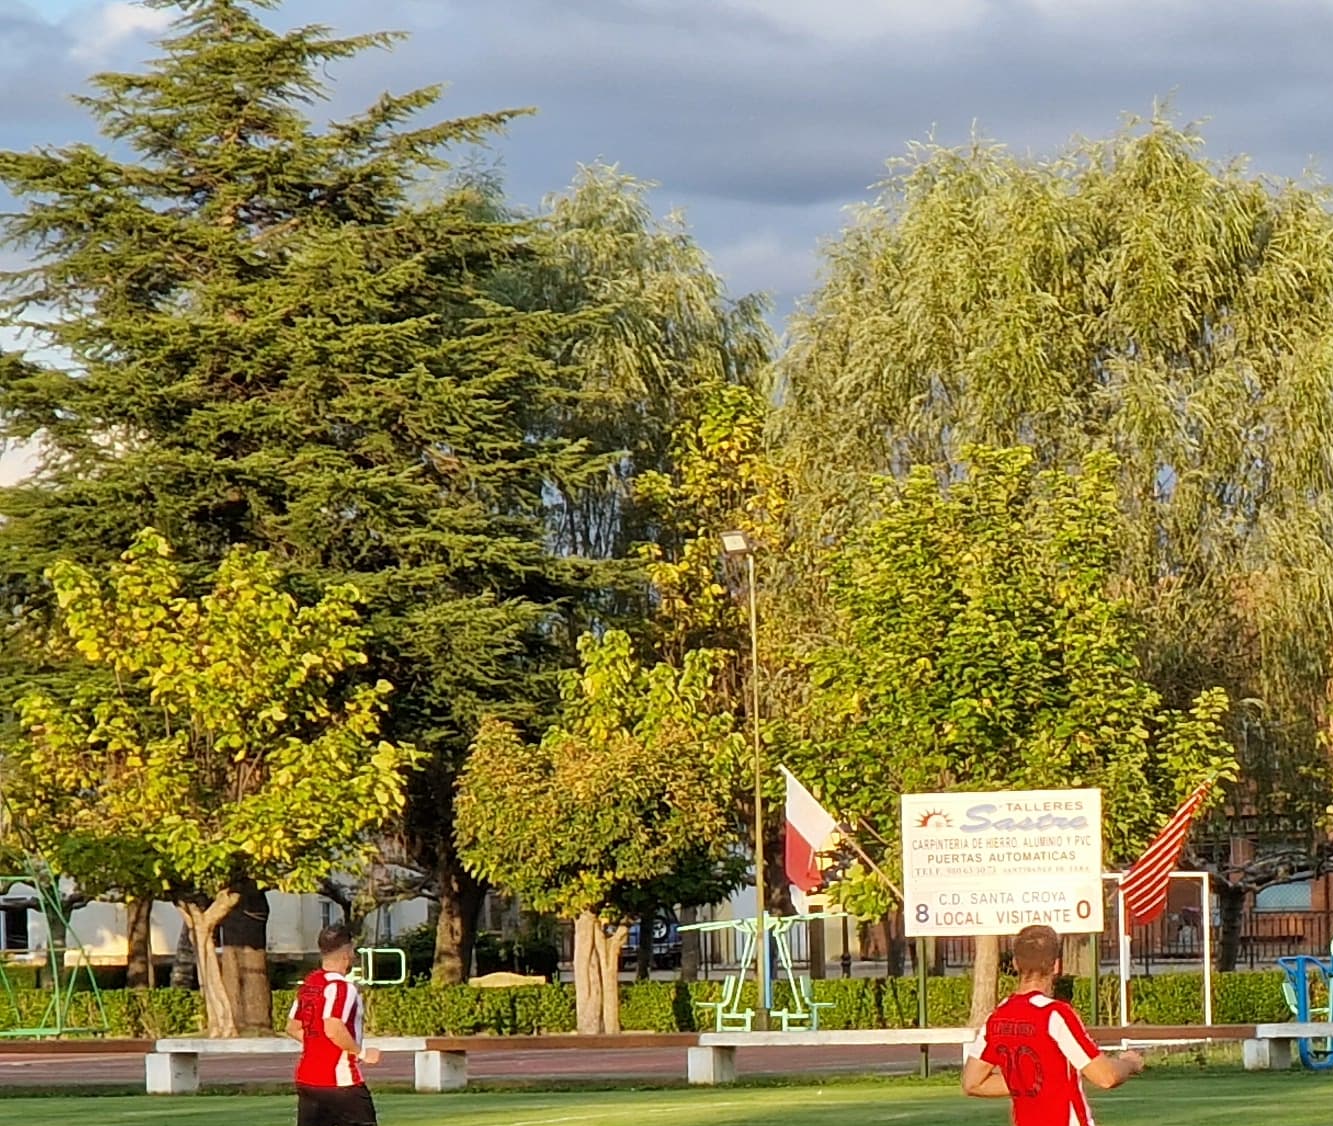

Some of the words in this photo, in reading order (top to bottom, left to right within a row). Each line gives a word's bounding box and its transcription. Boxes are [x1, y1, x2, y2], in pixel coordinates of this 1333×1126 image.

[1006, 801, 1083, 812] TALLERES
[960, 804, 1088, 833] Sastre
[912, 838, 970, 850] CARPINTERIA
[972, 838, 983, 849] DE
[1023, 836, 1063, 848] ALUMINIO
[1066, 836, 1072, 846] Y
[1075, 835, 1092, 846] PVC
[927, 853, 983, 864] PUERTAS
[988, 851, 1076, 863] AUTOMATICAS
[939, 893, 964, 905] C.D.
[970, 892, 1014, 905] SANTA
[1022, 891, 1067, 903] CROYA
[915, 903, 930, 923] 8
[935, 911, 983, 926] LOCAL
[996, 909, 1071, 924] VISITANTE
